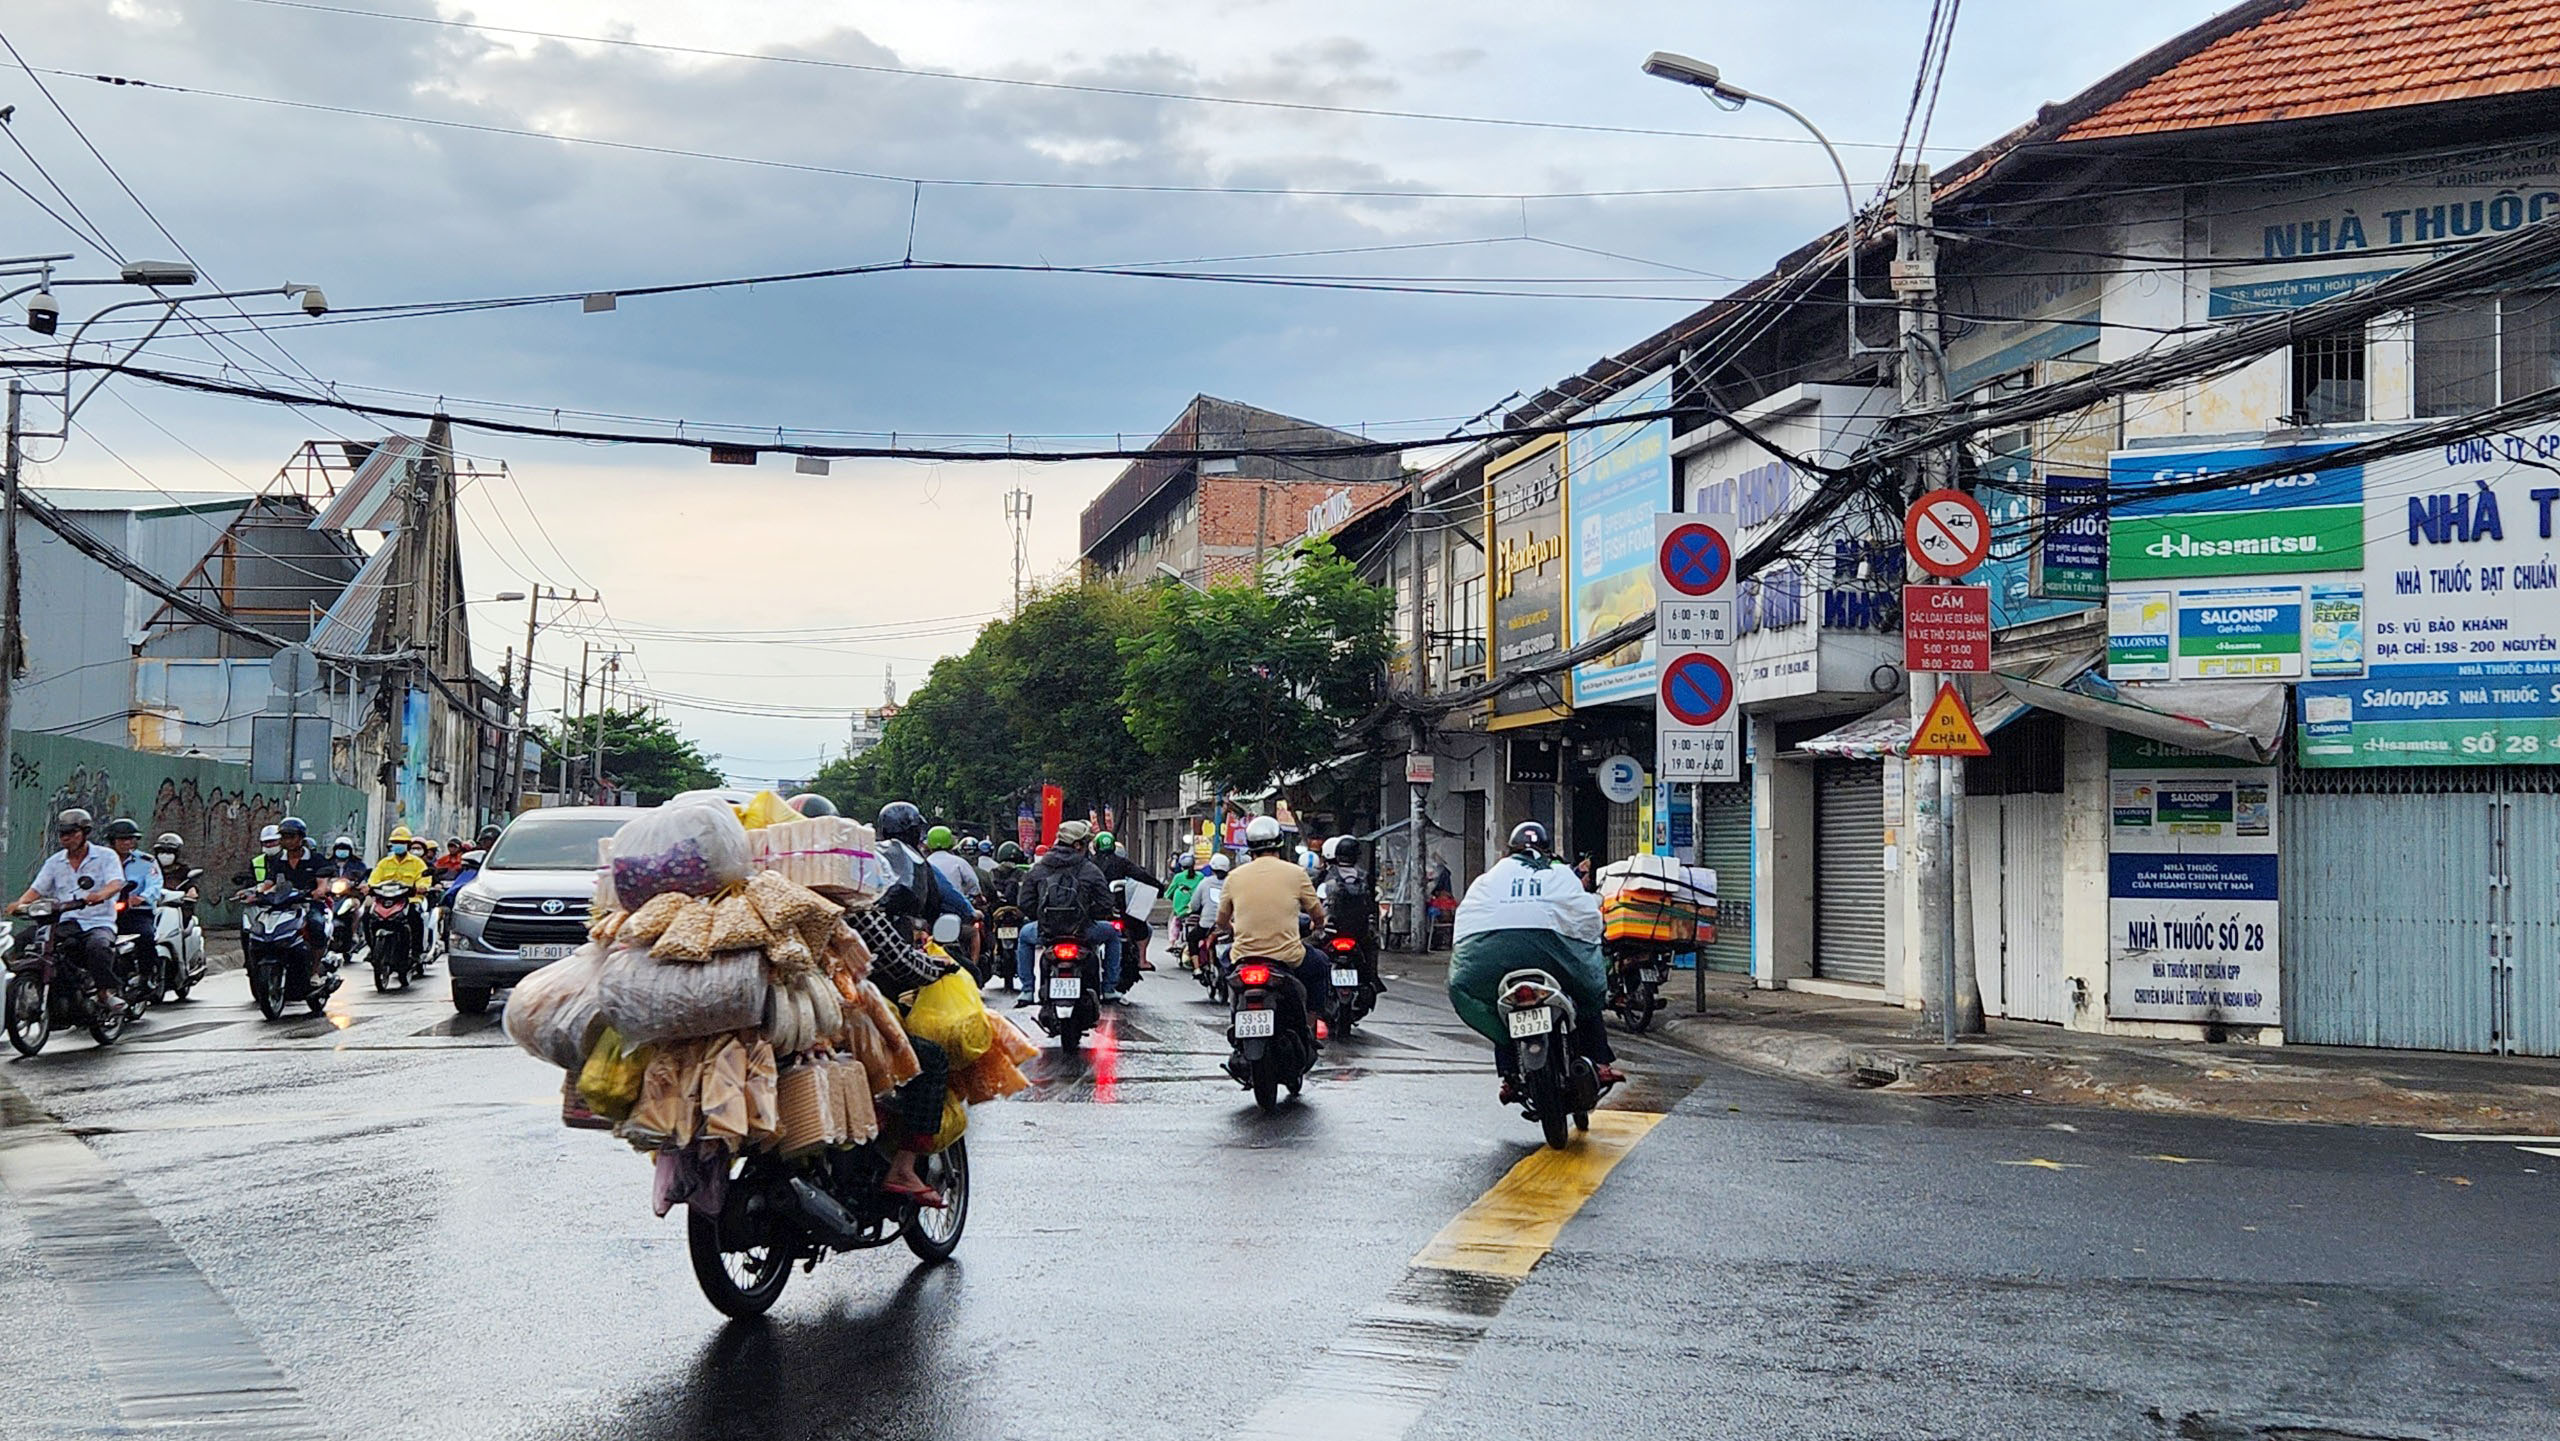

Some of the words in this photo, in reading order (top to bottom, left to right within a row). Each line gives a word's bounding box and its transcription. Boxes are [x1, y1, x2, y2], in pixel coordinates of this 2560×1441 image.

[2264, 208, 2368, 259] NHÀ
[2303, 282, 2321, 294] THỊ
[2504, 437, 2526, 462] TY
[2409, 480, 2504, 545] NHÀ
[2146, 534, 2317, 559] Hisamitsu
[2396, 564, 2422, 595] NHÀ
[2429, 559, 2473, 594] THUỐC
[2481, 566, 2505, 597] ĐẠT
[2513, 552, 2557, 590] CHUẨN
[1931, 590, 1964, 608] CẤM
[1672, 609, 1691, 621] 6:00
[1701, 609, 1719, 621] 9:00
[1910, 611, 1925, 623] CÁC
[1944, 613, 1953, 623] XE
[1964, 611, 1985, 624] BÁNH
[2201, 608, 2278, 625] SALONSIP
[2217, 624, 2263, 633] Gel-Patch
[2377, 623, 2399, 634] DS:
[2404, 618, 2421, 633] VŨ
[2428, 616, 2455, 632] BẢO
[2462, 615, 2508, 631] KHÁNH
[1668, 629, 1691, 641] 16:00
[1701, 629, 1724, 641] 19:00
[1908, 629, 1918, 640] VÀ
[1919, 630, 1929, 640] XE
[1966, 628, 1987, 641] BÁNH
[2109, 636, 2167, 648] SALONPAS
[2377, 643, 2399, 657] ĐỊA
[2404, 638, 2431, 654] CHỈ:
[2434, 641, 2458, 653] 198
[2470, 641, 2495, 653] 200
[2502, 634, 2557, 652] NGUYỄN
[1924, 644, 1941, 654] 5:00
[1951, 645, 1972, 654] 13:00
[1951, 660, 1974, 669] 22:00
[2459, 663, 2484, 676] NHÀ
[2485, 661, 2523, 675] THUỐC
[2525, 661, 2550, 675] BÁN
[2361, 688, 2449, 709] Salonpas
[2460, 687, 2489, 703] NHÀ
[2492, 684, 2540, 704] THUỐC
[1942, 716, 1954, 725] ĐI
[2310, 723, 2349, 733] Salonpas
[1672, 739, 1690, 750] 9:00
[1701, 739, 1724, 750] 16:00
[1930, 732, 1967, 749] CHẬM
[2363, 737, 2449, 751] Hisamitsu
[2462, 729, 2498, 753] SỐ
[2505, 735, 2540, 754] 28
[1672, 758, 1695, 770] 19:00
[1704, 759, 1724, 770] 6:00
[2171, 793, 2219, 803] SALONSIP
[2164, 863, 2184, 872] NHÀ
[2186, 862, 2218, 872] THUỐC
[2137, 872, 2157, 880] BÁN
[2159, 871, 2186, 881] HÀNG
[2132, 879, 2151, 889] CỦA
[2153, 882, 2206, 890] HISAMITSU
[2207, 880, 2229, 891] VIỆT
[2231, 883, 2253, 891] NAM
[2129, 914, 2158, 949] NHÀ
[2164, 912, 2214, 950] THUỐC
[2219, 912, 2240, 951] SỐ
[2245, 923, 2264, 951] 28
[2153, 960, 2165, 978] NHÀ
[2167, 958, 2188, 979] THUỐC
[2190, 963, 2203, 981] ĐẠT
[2204, 957, 2226, 979] CHUẨN
[2228, 965, 2240, 980] GPP
[2161, 986, 2174, 1004] BÁN
[2186, 985, 2207, 1006] THUỐC
[1242, 1013, 1267, 1024] 59-S3
